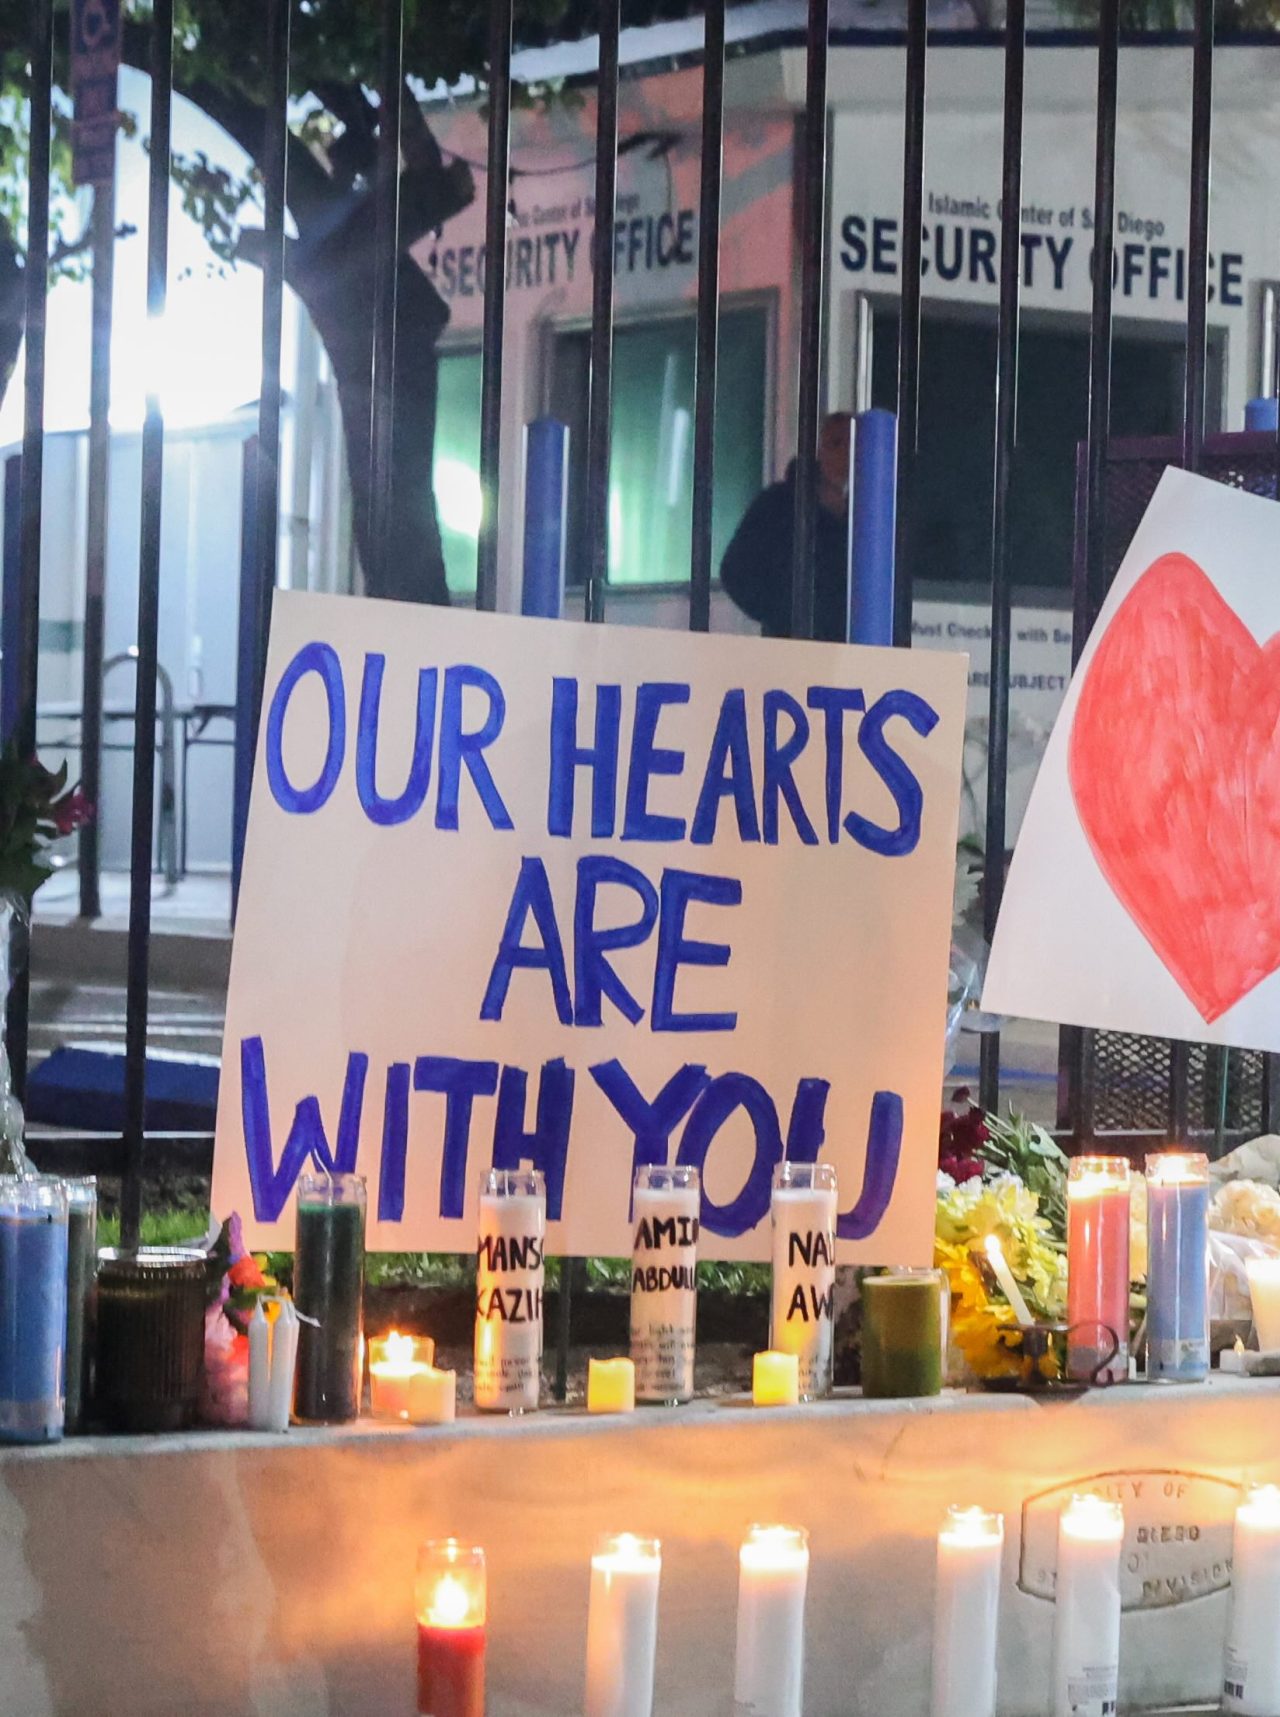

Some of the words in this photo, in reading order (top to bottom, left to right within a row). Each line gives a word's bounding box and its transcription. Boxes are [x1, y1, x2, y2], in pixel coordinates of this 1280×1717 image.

[441, 229, 580, 298] SECRITY
[590, 209, 695, 277] FFICE
[840, 214, 1074, 290] SEURTY
[1089, 243, 1243, 306] FFIE
[928, 191, 991, 218] Islamic
[996, 198, 1054, 225] nter
[1059, 207, 1075, 227] of
[1117, 211, 1165, 241] Diego
[265, 640, 514, 832] OUR
[547, 676, 941, 857] HEARTS
[479, 855, 742, 1032] ARE
[240, 1035, 575, 1223] WITH
[588, 1057, 904, 1241] YOU
[477, 1233, 544, 1272] MANS
